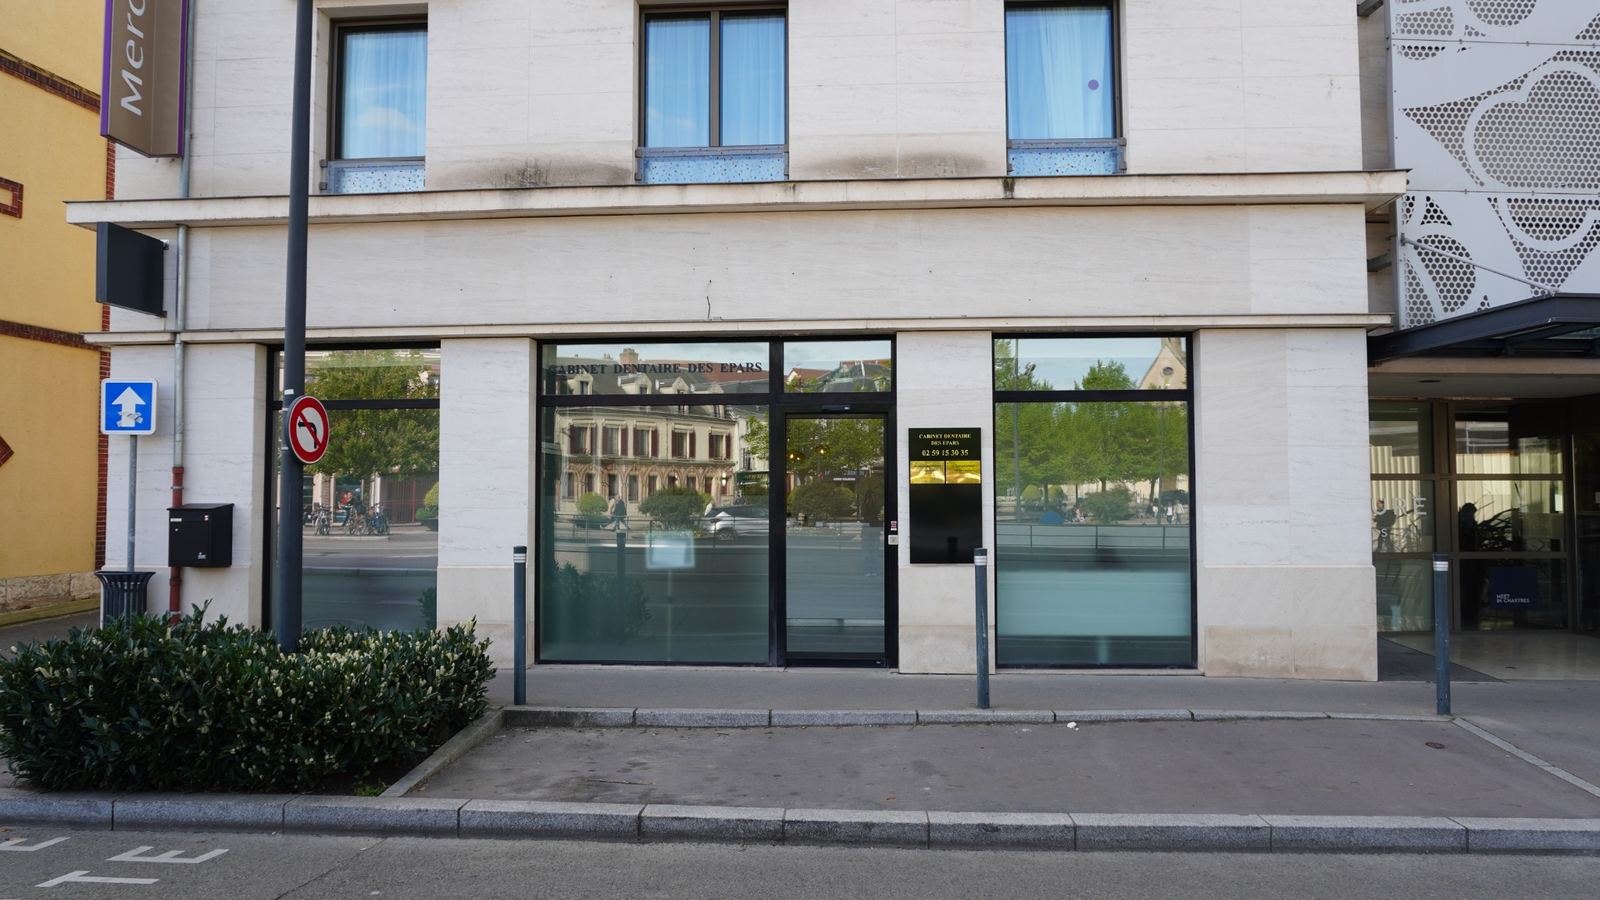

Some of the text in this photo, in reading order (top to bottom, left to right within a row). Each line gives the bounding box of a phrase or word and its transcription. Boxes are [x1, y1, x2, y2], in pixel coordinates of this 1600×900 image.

[547, 362, 763, 375] CABINET DENTAIRE DES EPARS
